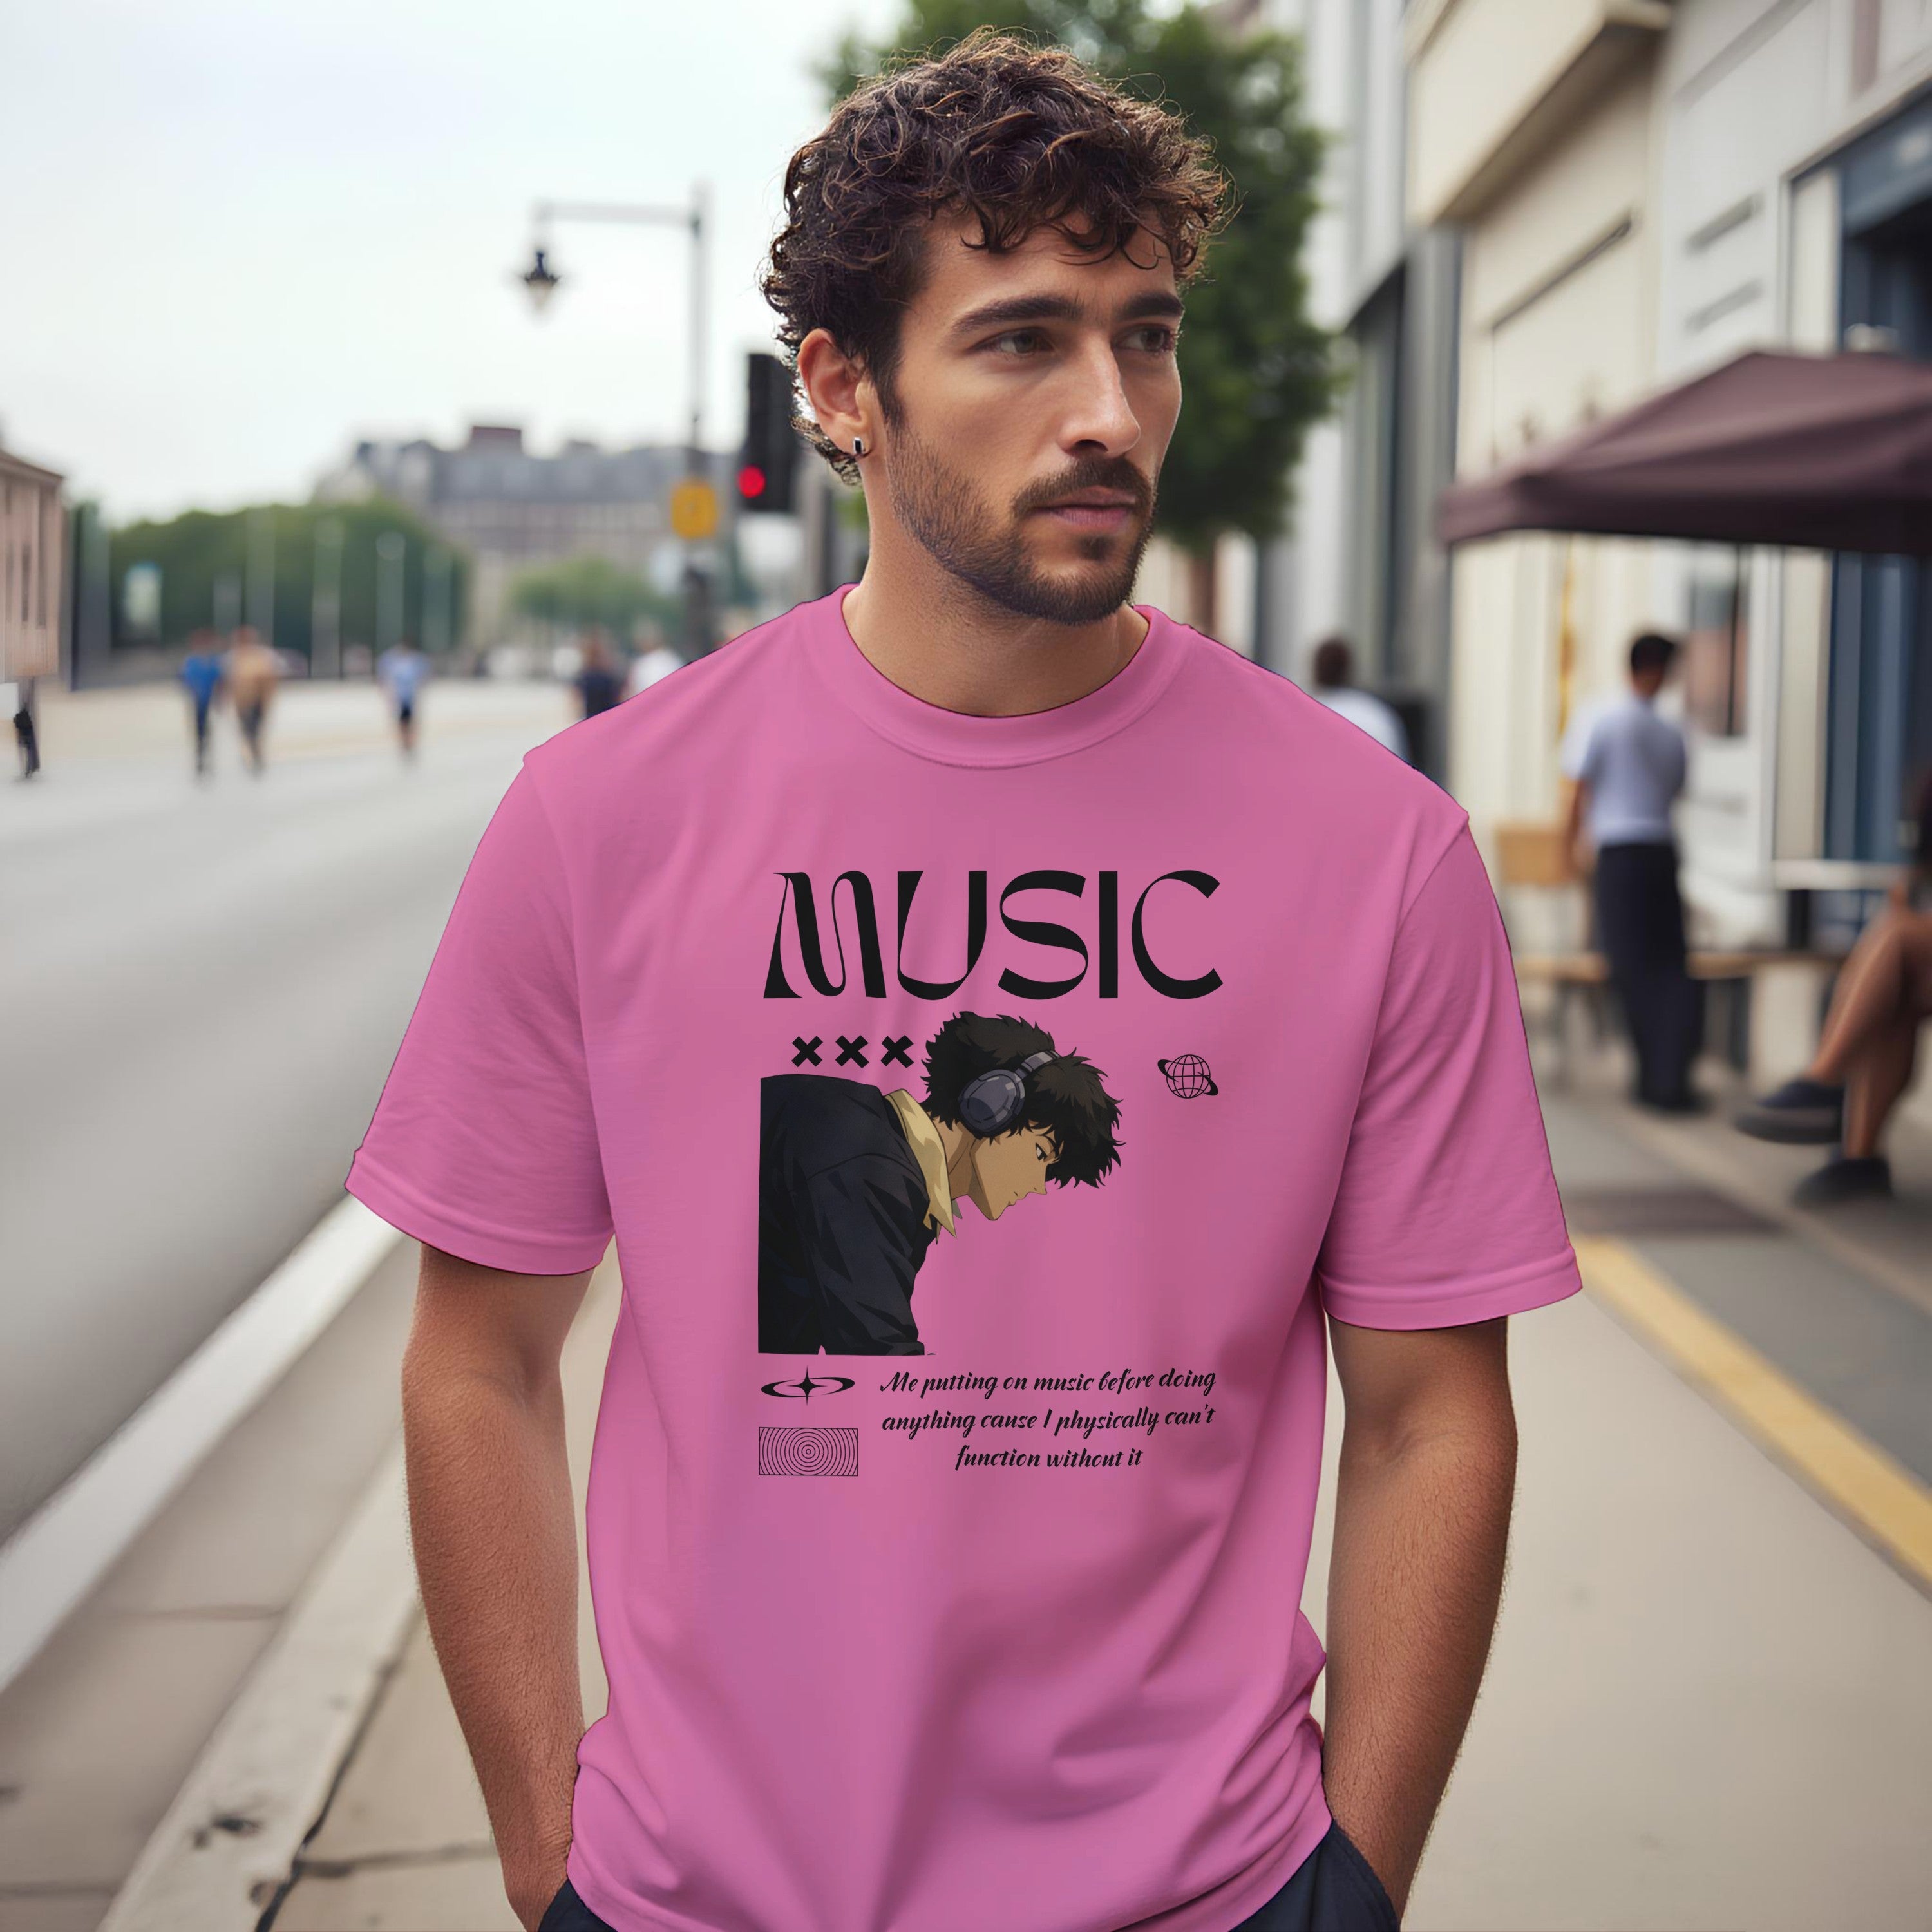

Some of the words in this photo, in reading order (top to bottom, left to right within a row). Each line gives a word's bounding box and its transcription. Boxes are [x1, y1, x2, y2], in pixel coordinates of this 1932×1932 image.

[762, 869, 1224, 1001] MUSIC
[880, 1371, 918, 1392] Me
[920, 1372, 998, 1400] putting
[1003, 1376, 1028, 1390] on
[1033, 1373, 1095, 1392] music
[1098, 1368, 1155, 1396] before
[1159, 1367, 1217, 1397] doing
[882, 1409, 976, 1440] anything
[980, 1414, 1038, 1430] cause
[1043, 1408, 1053, 1429] I
[1054, 1406, 1159, 1439] physically
[1164, 1403, 1217, 1426] can't
[954, 1444, 1041, 1472] function
[1046, 1448, 1124, 1468] without
[1127, 1448, 1144, 1467] it
